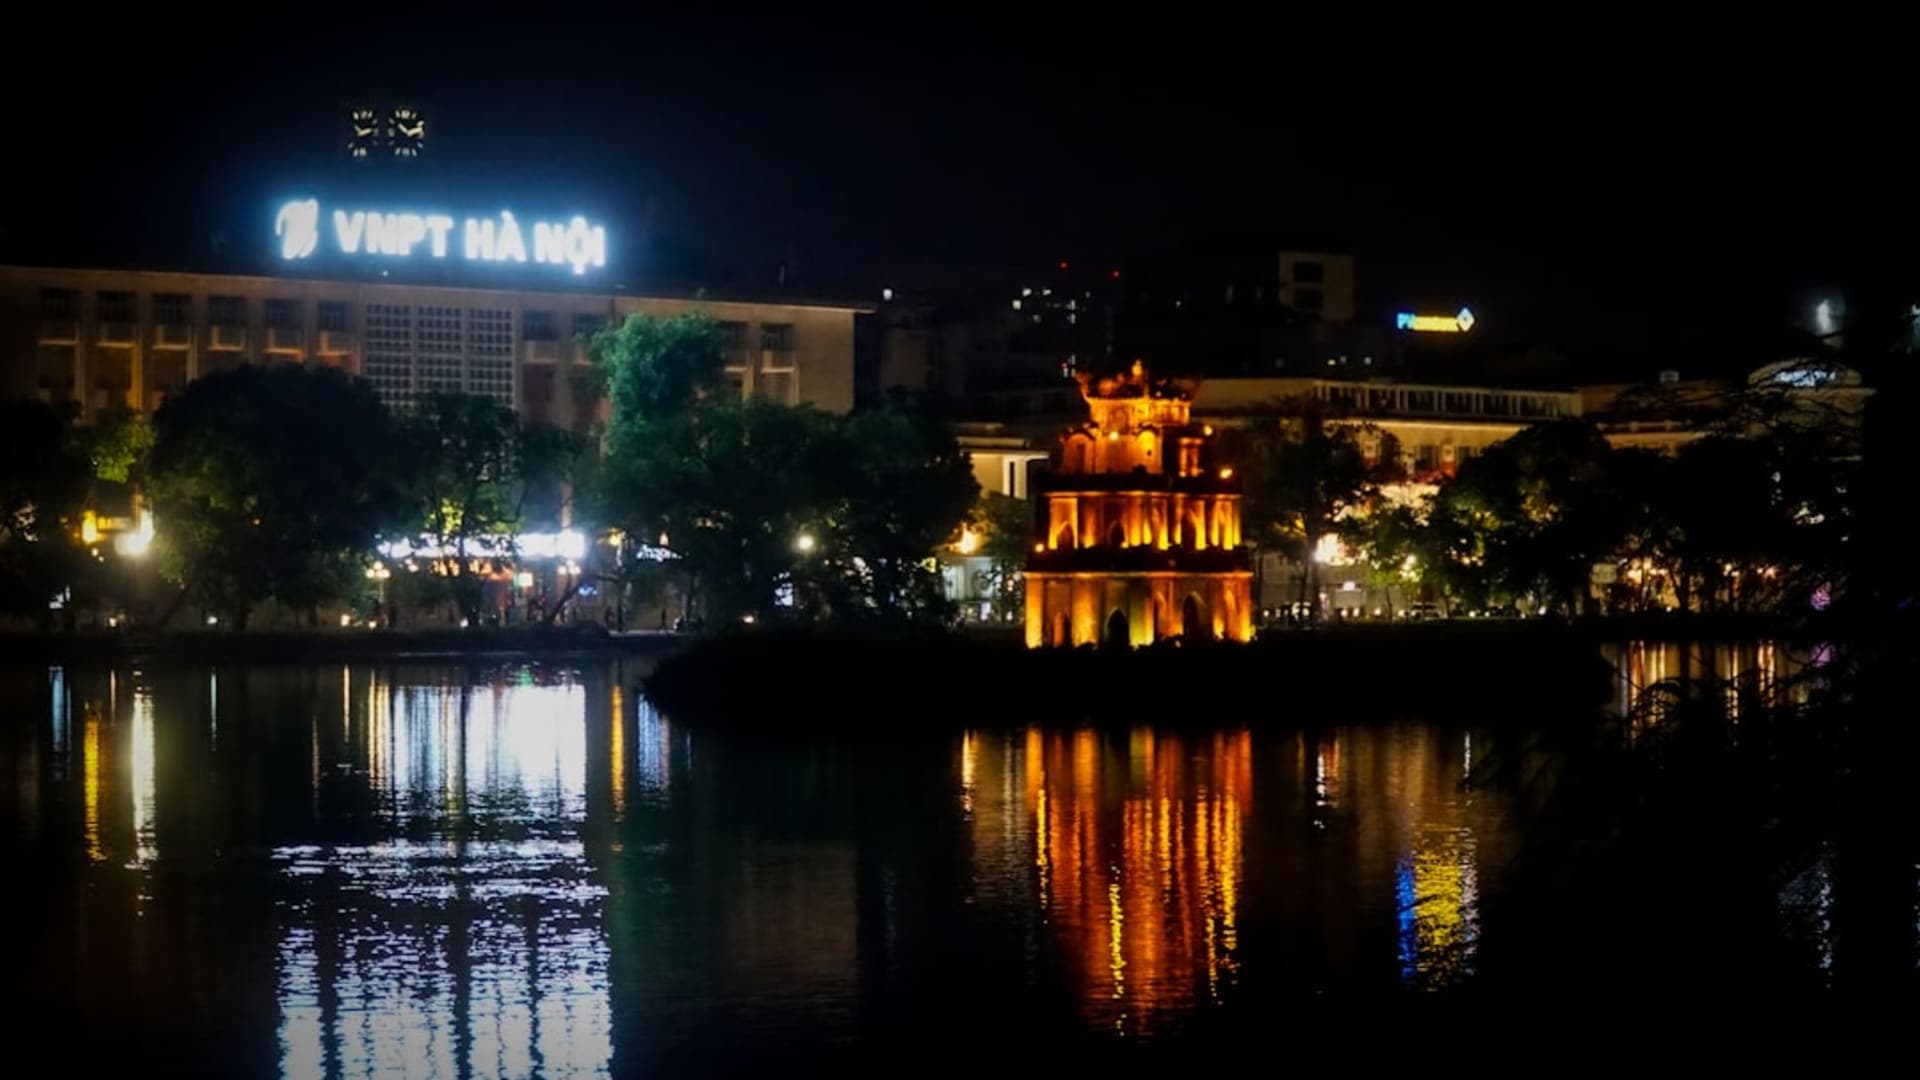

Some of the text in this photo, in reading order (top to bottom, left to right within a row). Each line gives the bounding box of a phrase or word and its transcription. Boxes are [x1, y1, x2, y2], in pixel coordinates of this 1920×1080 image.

[334, 209, 605, 275] VNPT HÀ NỘI
